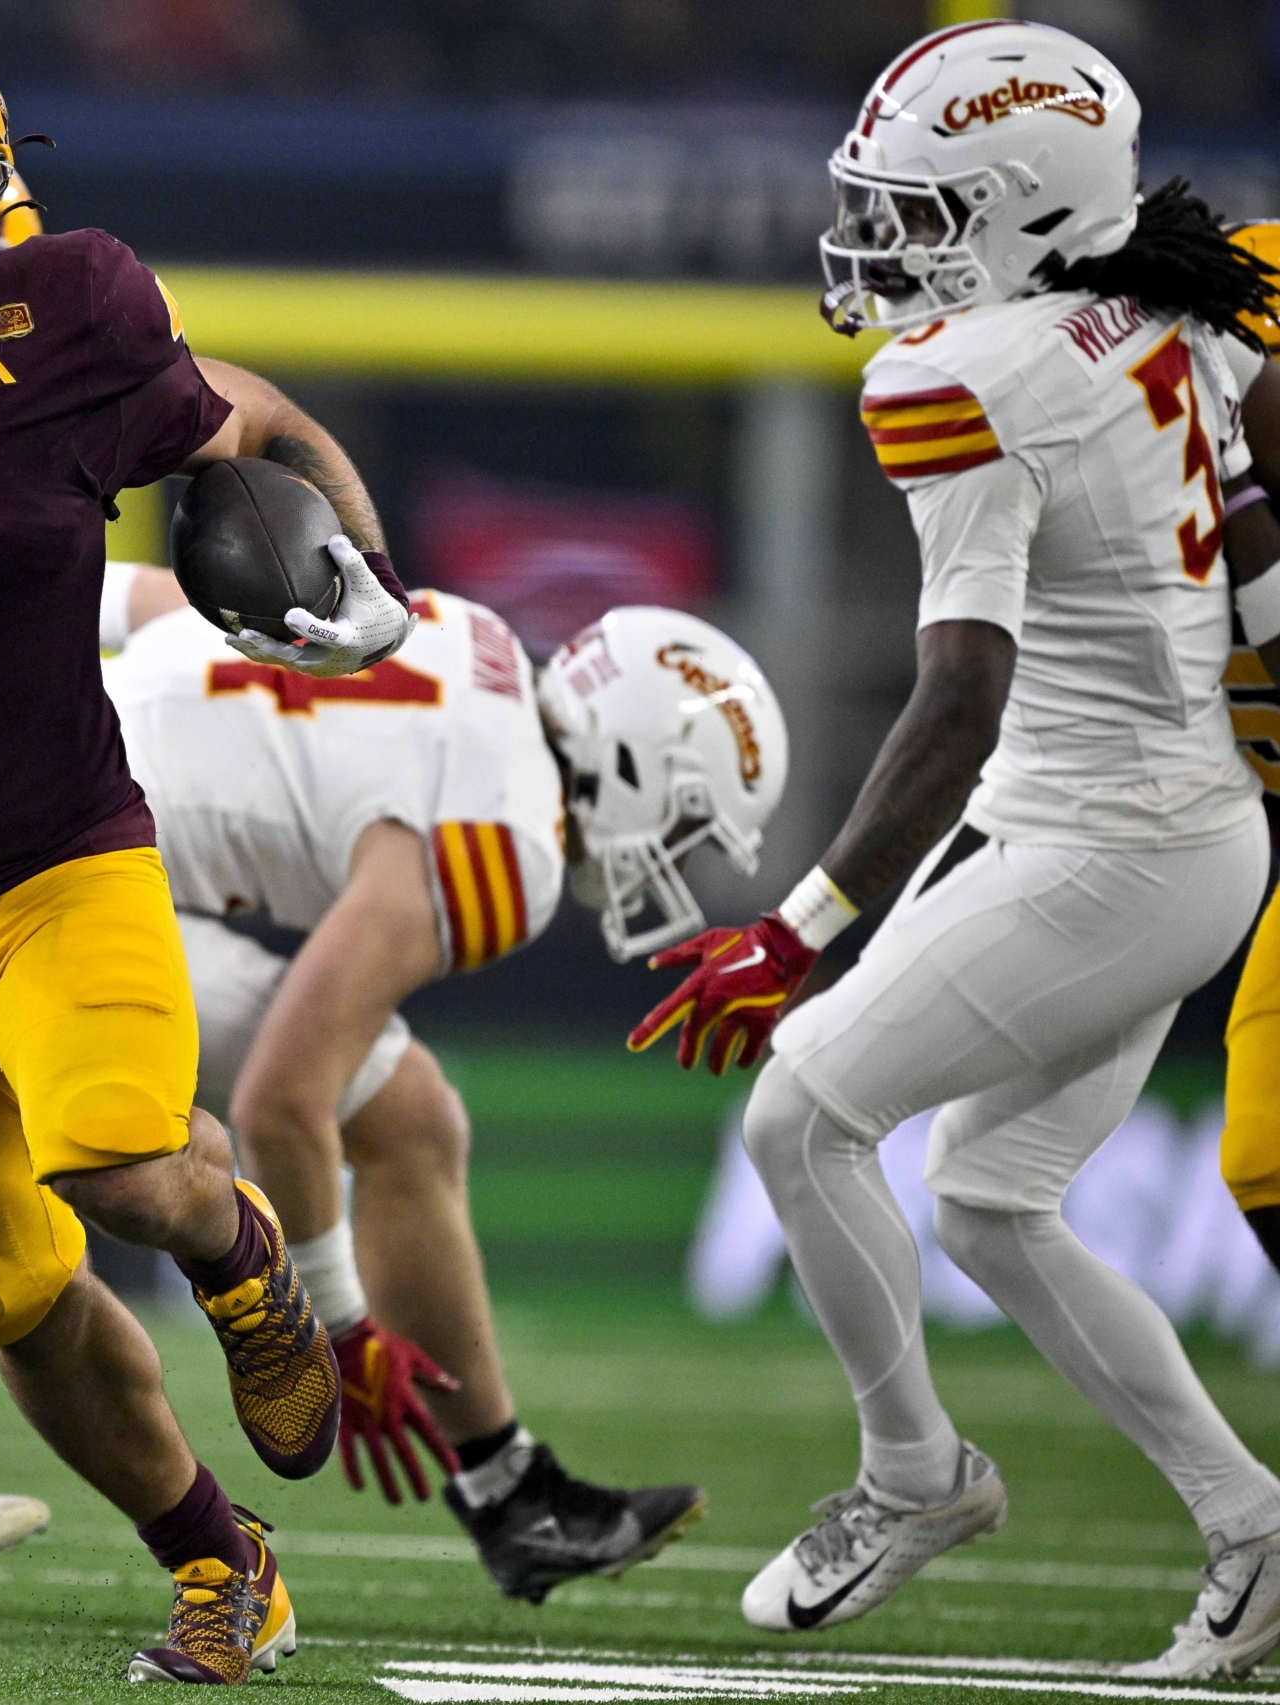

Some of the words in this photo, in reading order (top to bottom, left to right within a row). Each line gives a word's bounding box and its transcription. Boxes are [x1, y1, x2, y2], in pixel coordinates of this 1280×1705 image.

[943, 76, 1107, 131] Cyclones
[1053, 294, 1154, 364] WILLIA
[1125, 315, 1225, 586] 3
[308, 623, 340, 642] ADIZERO
